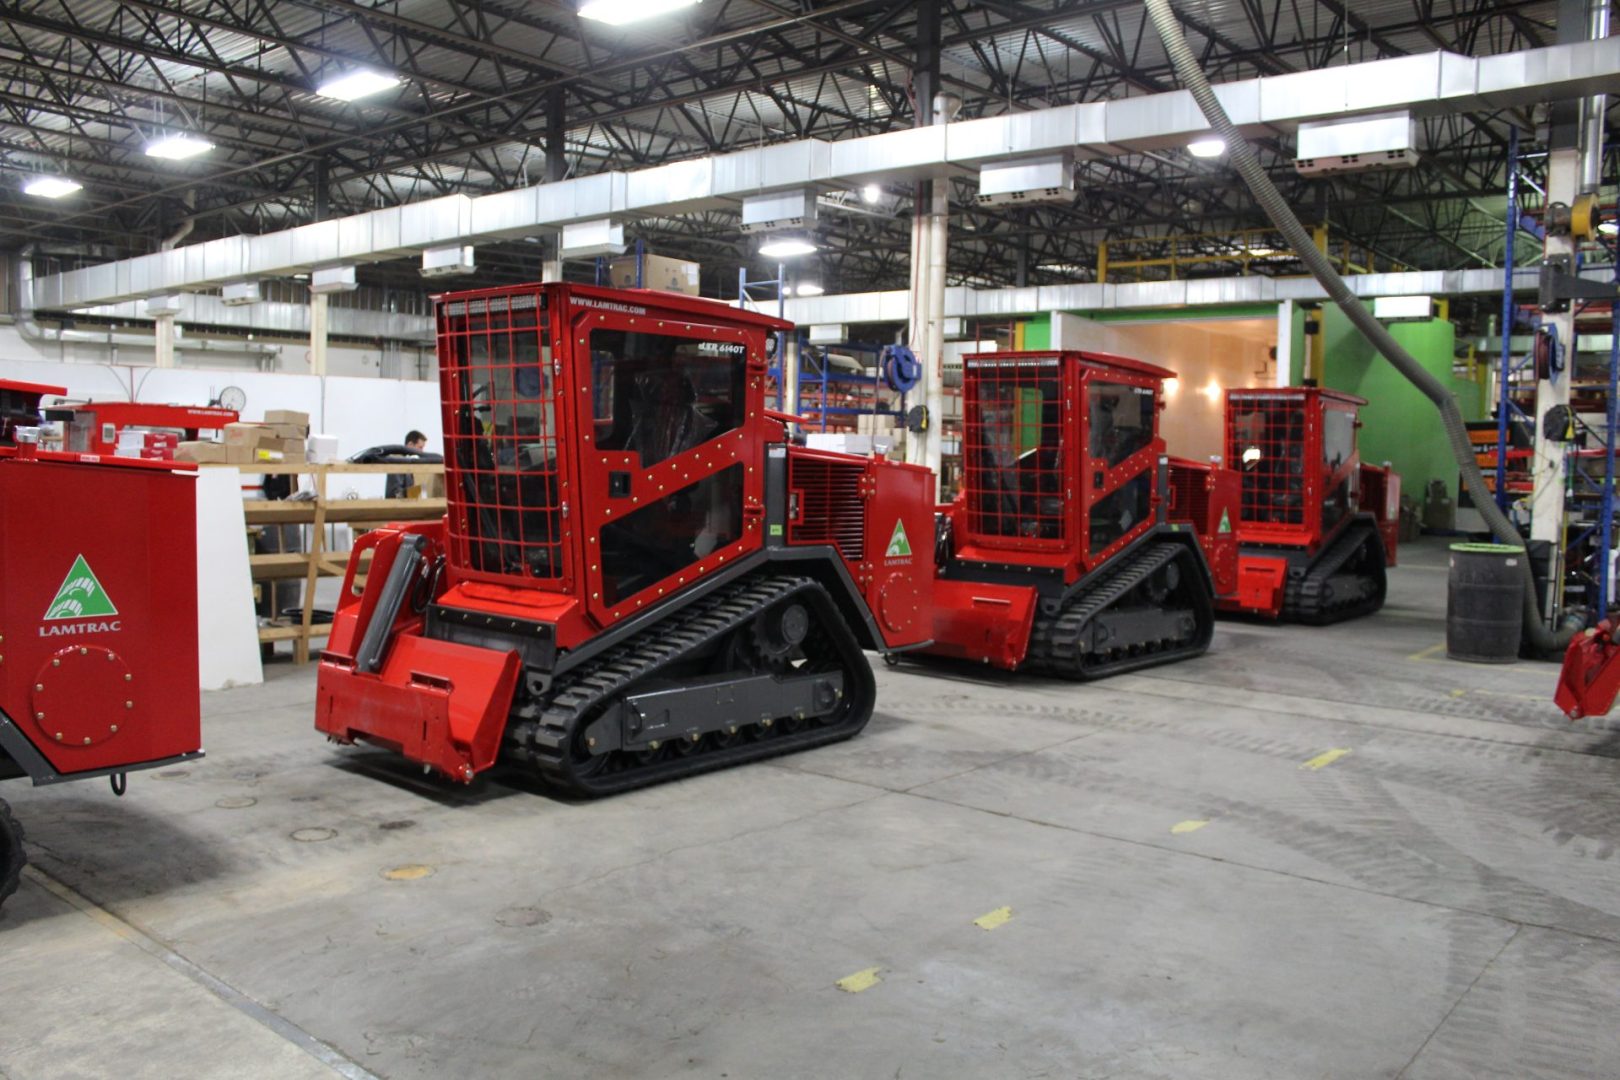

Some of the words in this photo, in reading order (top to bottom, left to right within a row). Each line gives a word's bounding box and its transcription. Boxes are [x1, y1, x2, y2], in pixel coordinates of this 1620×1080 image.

[569, 296, 647, 315] WWW.LAMTRAC.COM
[719, 344, 745, 354] 6140T
[38, 620, 121, 637] LAMTRAC
